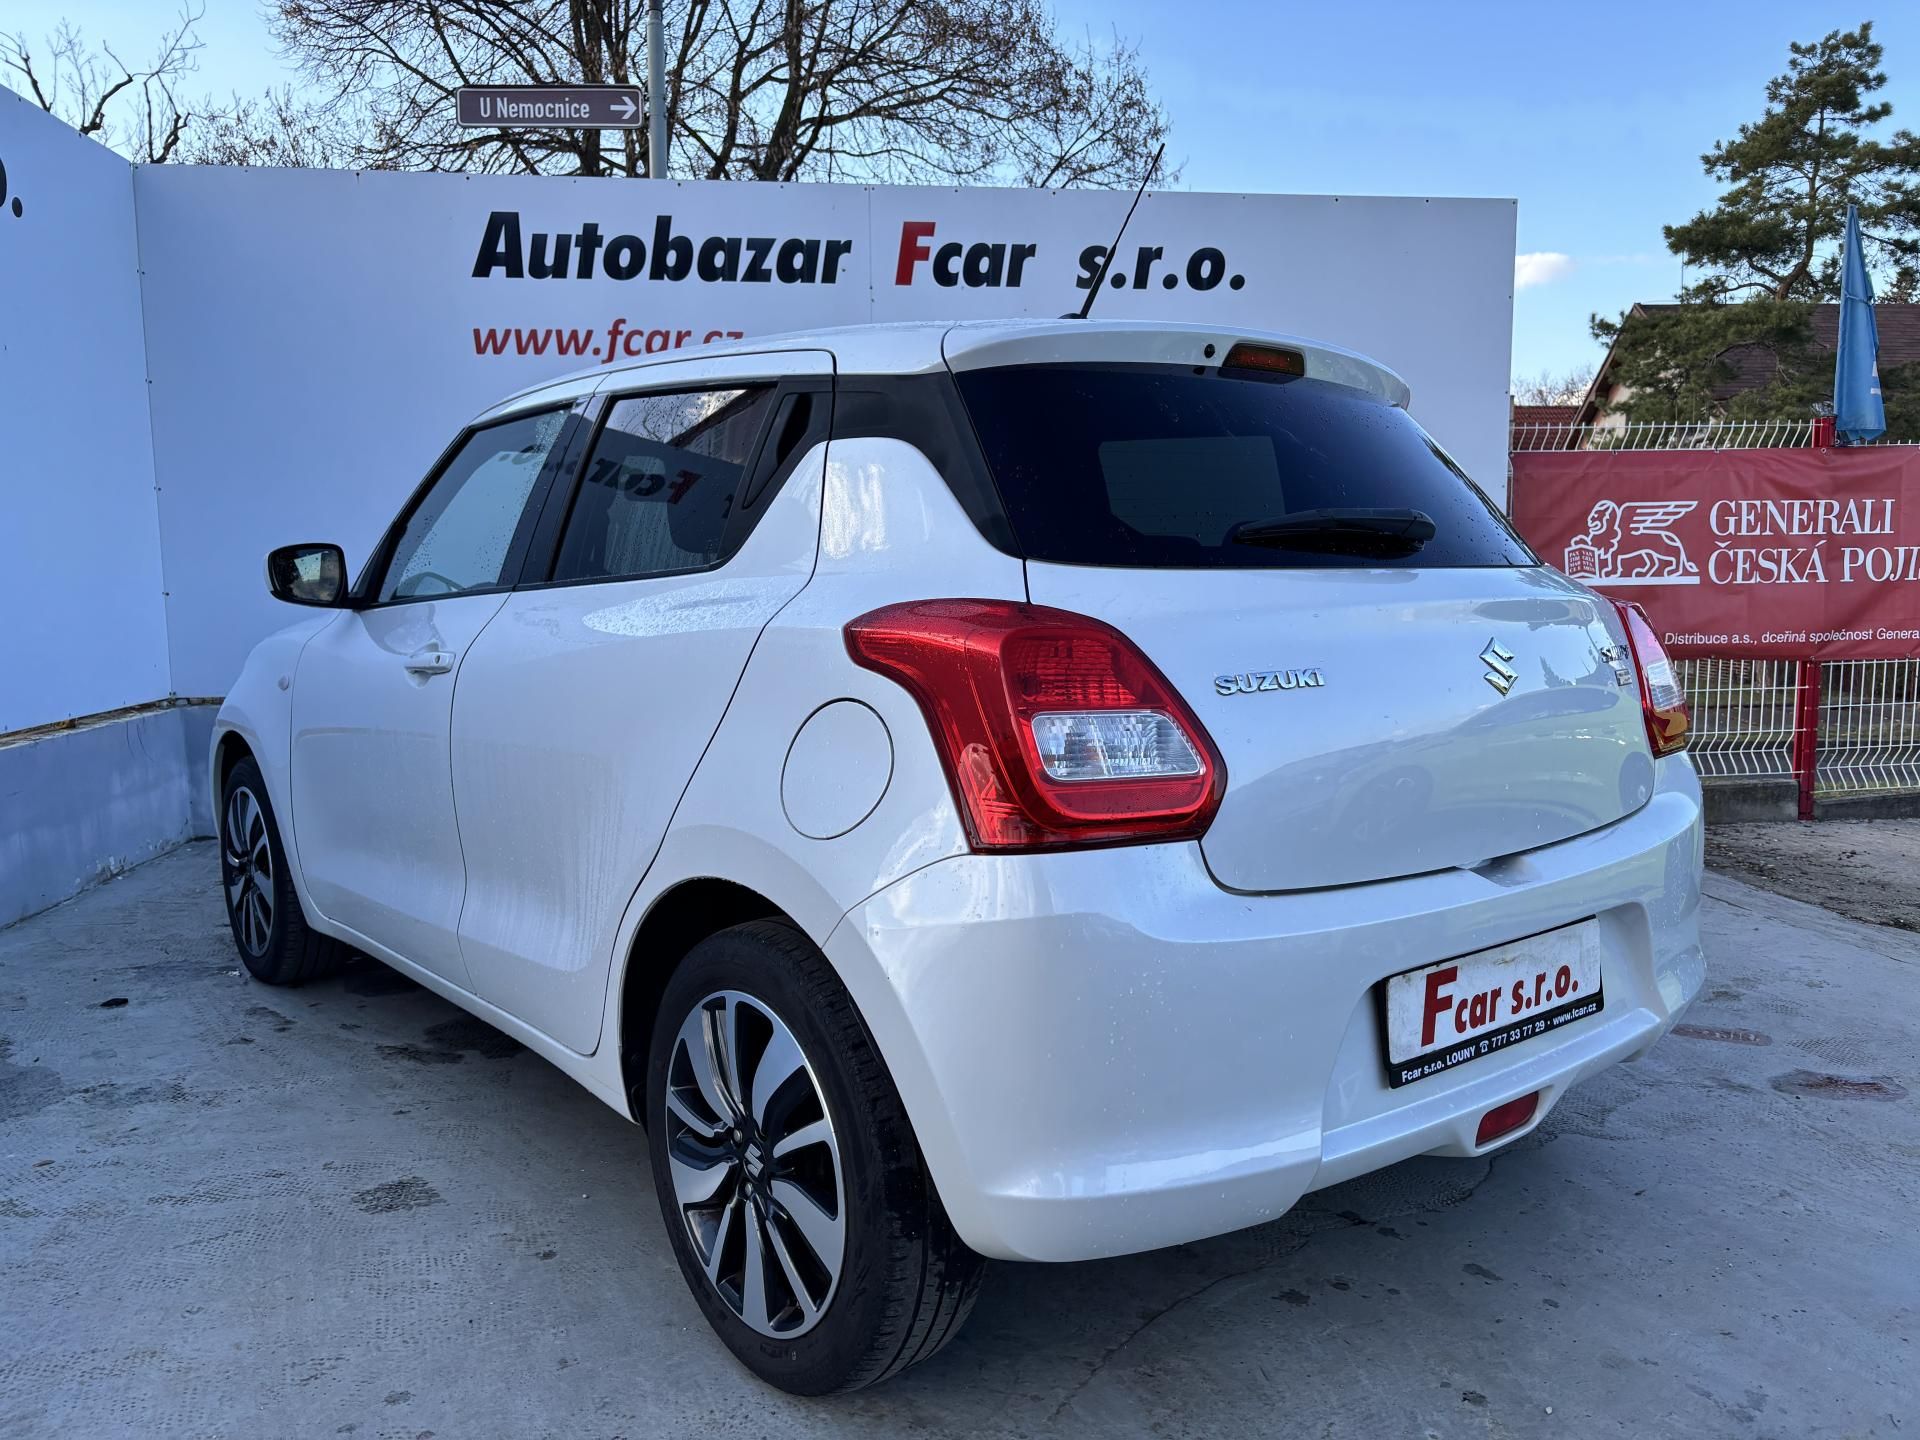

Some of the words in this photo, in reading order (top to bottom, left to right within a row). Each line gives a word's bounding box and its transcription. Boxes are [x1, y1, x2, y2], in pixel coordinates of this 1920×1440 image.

[480, 97, 491, 118] U
[497, 97, 590, 119] Nemocnice
[471, 211, 853, 284] Autobazar
[895, 221, 1037, 288] Fcar
[1076, 245, 1246, 291] s.r.o.
[473, 318, 744, 364] www.fcar
[1709, 499, 1896, 536] GENERALI
[1708, 540, 1835, 585] ČESKÁ
[1840, 547, 1920, 582] POJI
[1664, 632, 1728, 645] Distribuce
[1731, 633, 1757, 645] a.s.,
[1761, 630, 1806, 644] dceřiná
[1809, 628, 1873, 645] společnost
[1214, 667, 1326, 696] SUZUKI
[1421, 966, 1502, 1048] Fcar
[1511, 965, 1579, 1015] s.r.o.
[1401, 1068, 1422, 1083] Fcar
[1424, 1060, 1445, 1074] s.r.o.
[1446, 1045, 1476, 1066] LOUNY
[1491, 1034, 1508, 1048] 777
[1509, 1029, 1521, 1041] 33
[1522, 1024, 1533, 1037] 77
[1534, 1020, 1546, 1033] 29
[1552, 1003, 1597, 1026] www.fcar.cz
